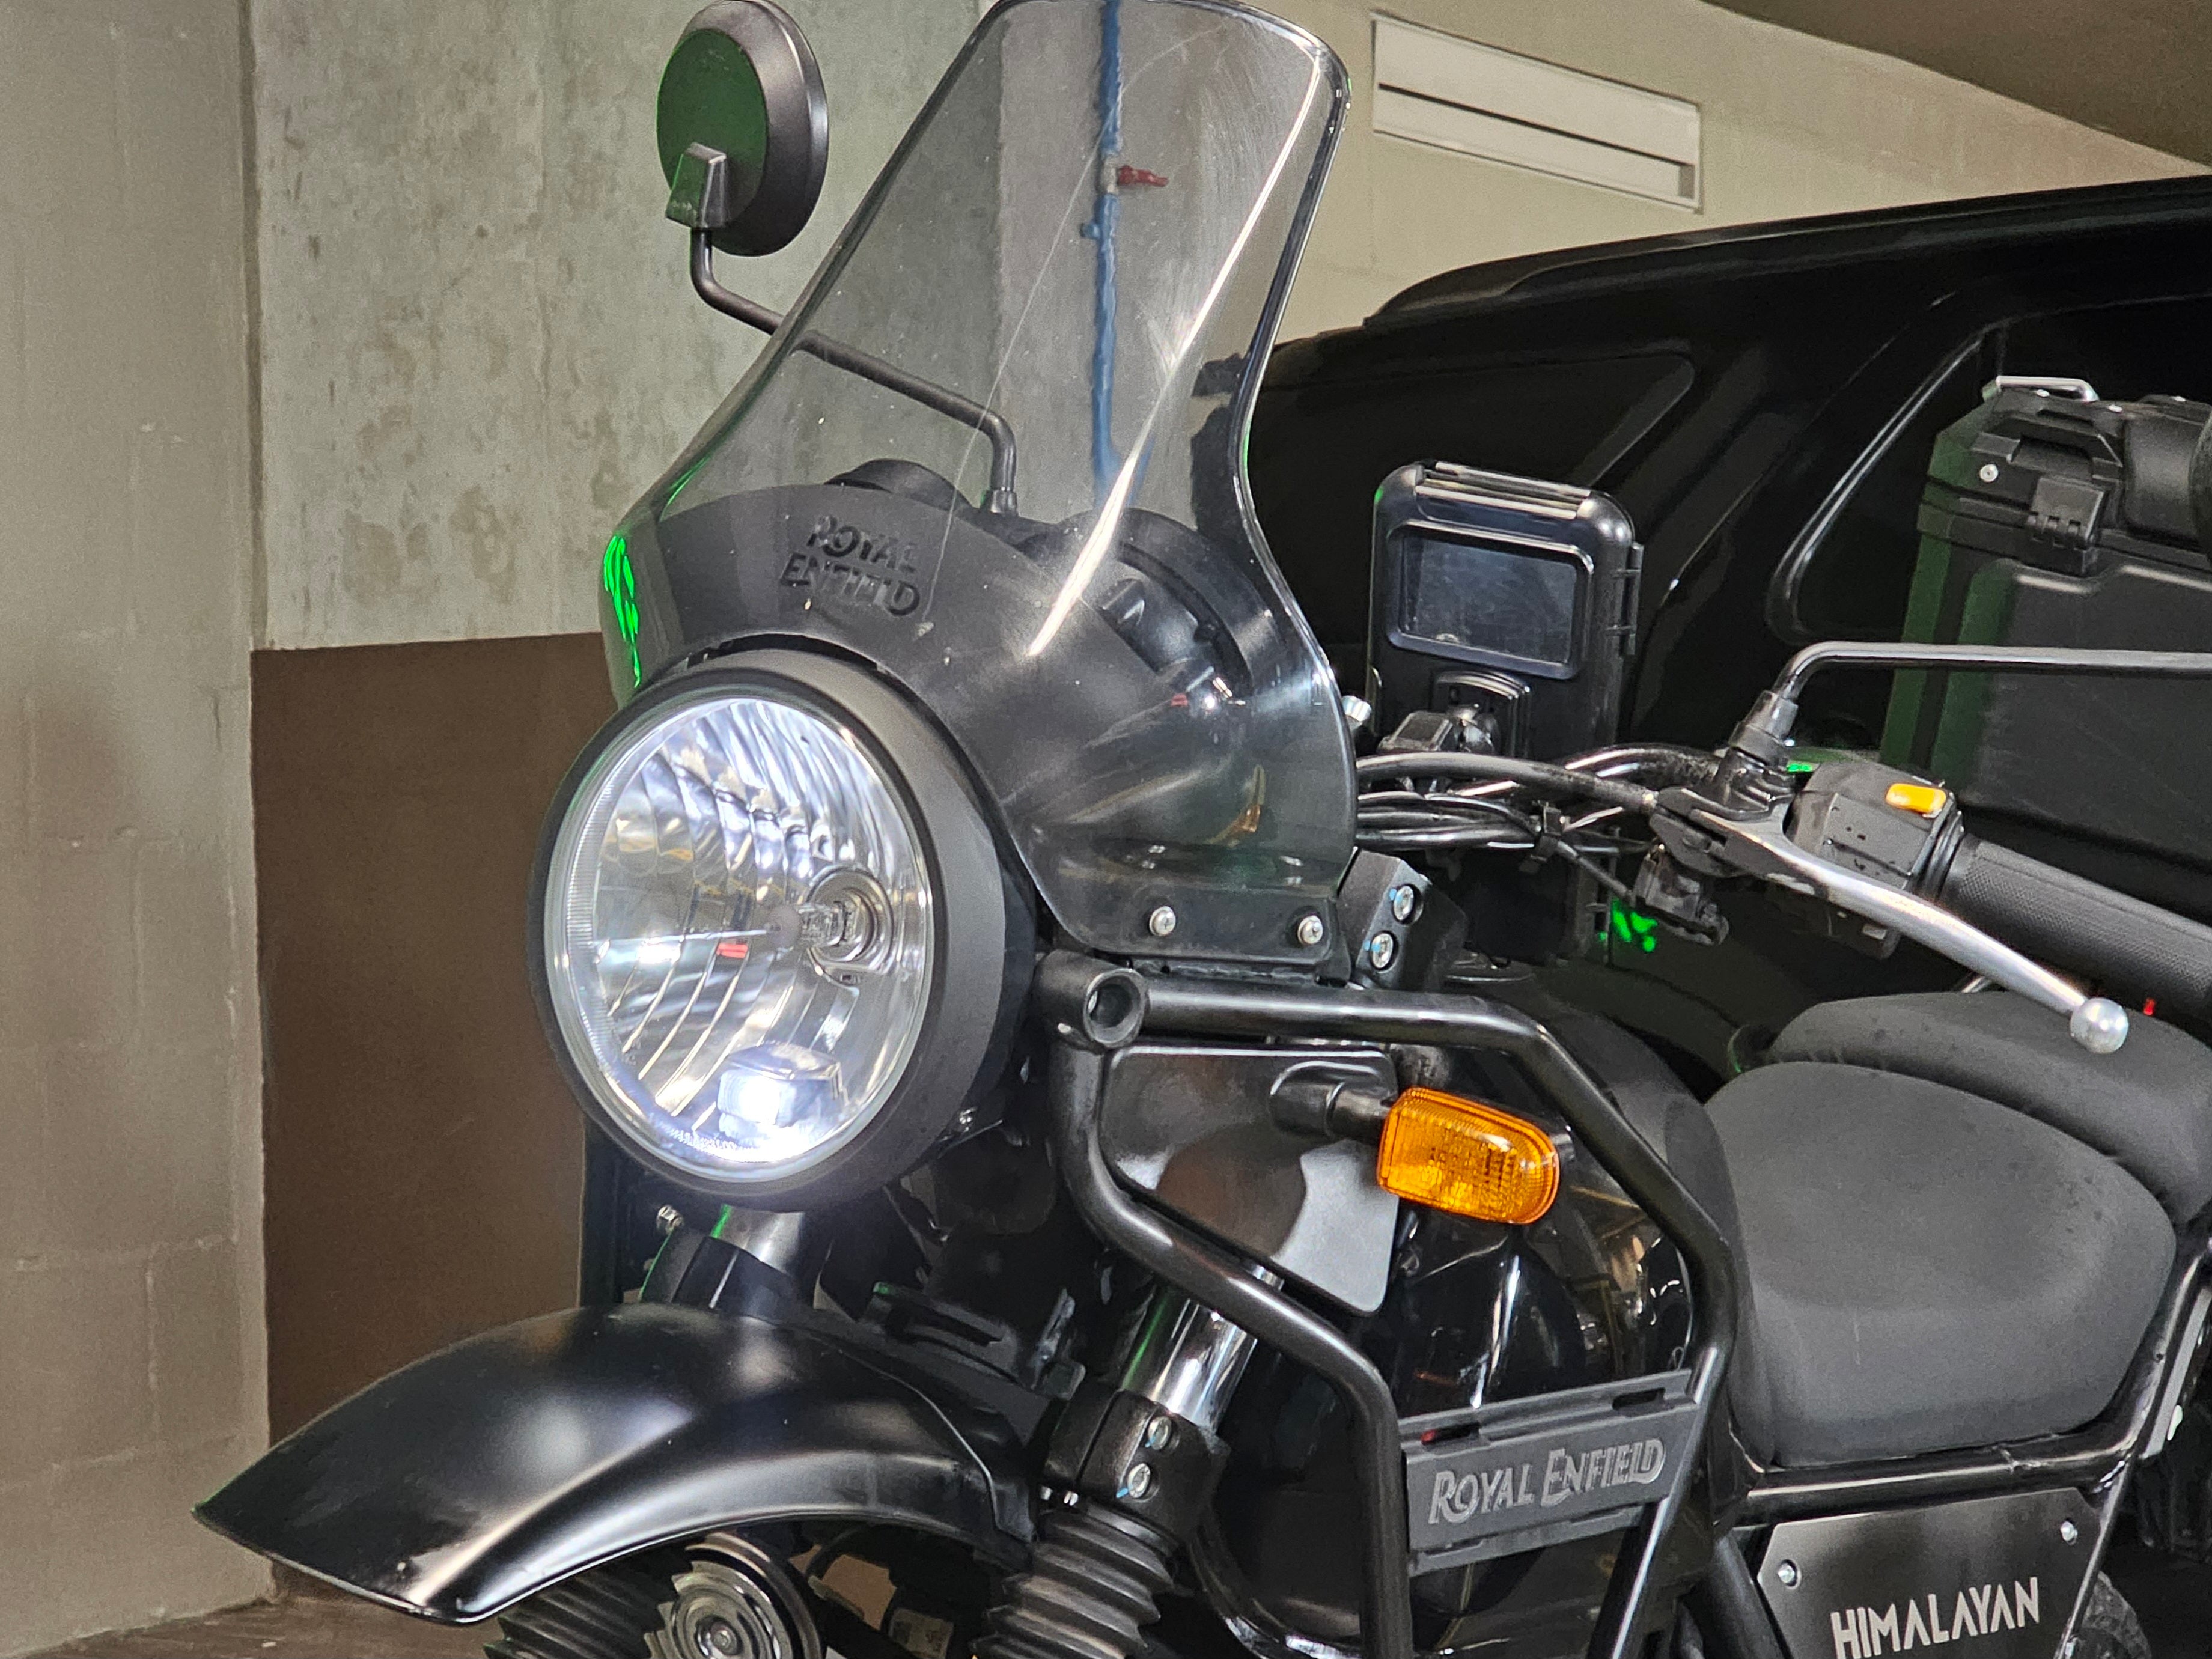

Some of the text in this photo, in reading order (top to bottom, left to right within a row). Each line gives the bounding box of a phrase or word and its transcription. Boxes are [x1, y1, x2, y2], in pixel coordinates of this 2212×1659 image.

[1428, 1439, 1666, 1525] ROYAL ENFIELD
[1830, 1576, 2040, 1659] HIMALAYAN
